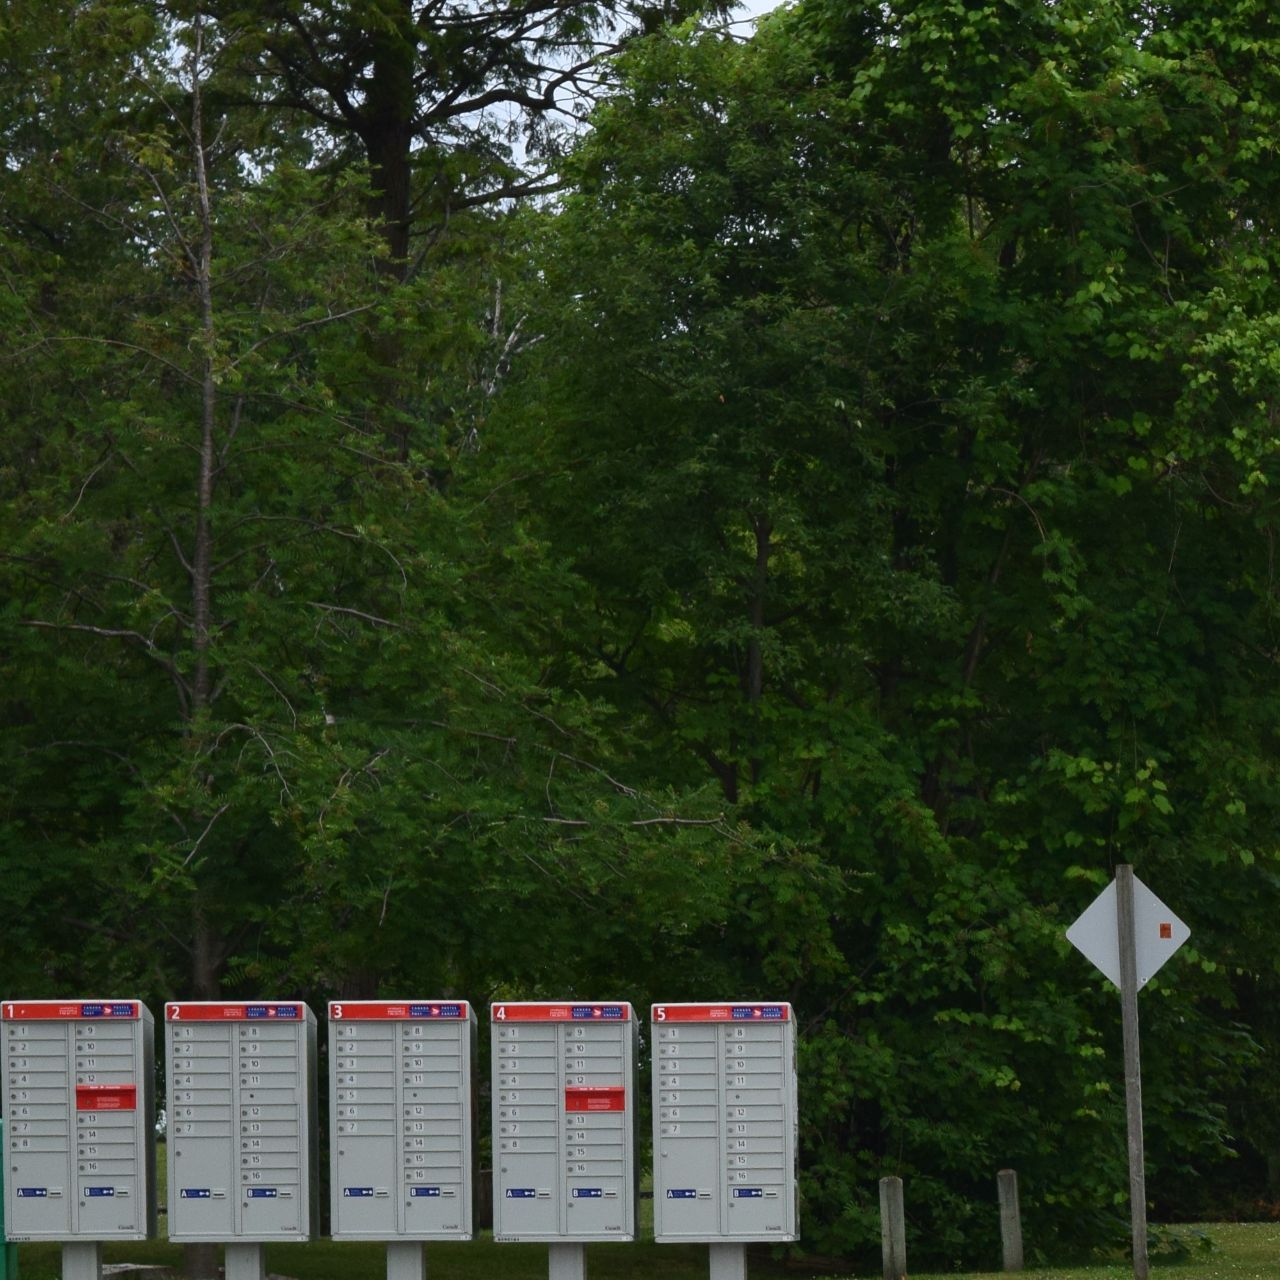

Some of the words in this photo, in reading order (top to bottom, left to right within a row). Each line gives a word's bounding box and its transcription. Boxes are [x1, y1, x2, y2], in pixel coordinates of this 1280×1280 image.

[7, 1005, 13, 1018] 1
[171, 1006, 180, 1019] 2
[334, 1005, 342, 1019] 3
[497, 1006, 506, 1020] 4
[657, 1008, 666, 1020] 5
